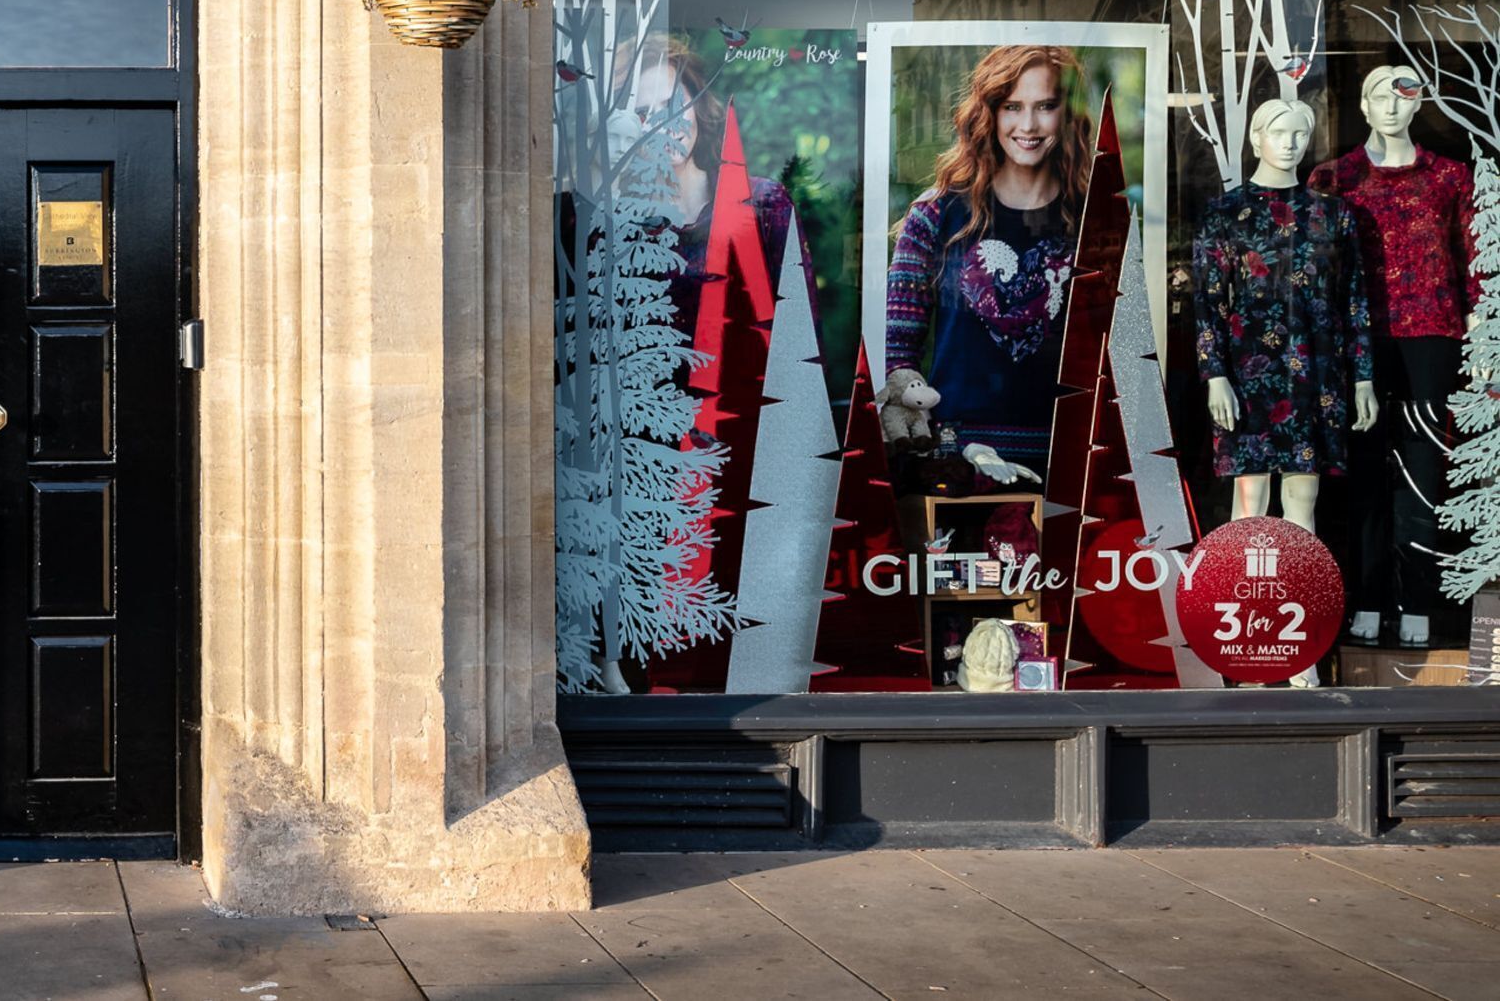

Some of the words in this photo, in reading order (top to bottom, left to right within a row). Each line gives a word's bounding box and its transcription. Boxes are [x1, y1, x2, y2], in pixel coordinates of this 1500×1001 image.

[724, 45, 788, 67] Country
[806, 43, 843, 64] Rose
[863, 552, 989, 596] GIFT
[1000, 553, 1068, 596] the
[1095, 549, 1206, 592] JOY
[1234, 581, 1287, 599] GIFTS
[1213, 602, 1242, 641] 3
[1246, 609, 1274, 638] for
[1277, 602, 1307, 641] 2
[1220, 644, 1244, 655] MIX
[1246, 644, 1255, 655] &
[1257, 644, 1299, 655] MATCH
